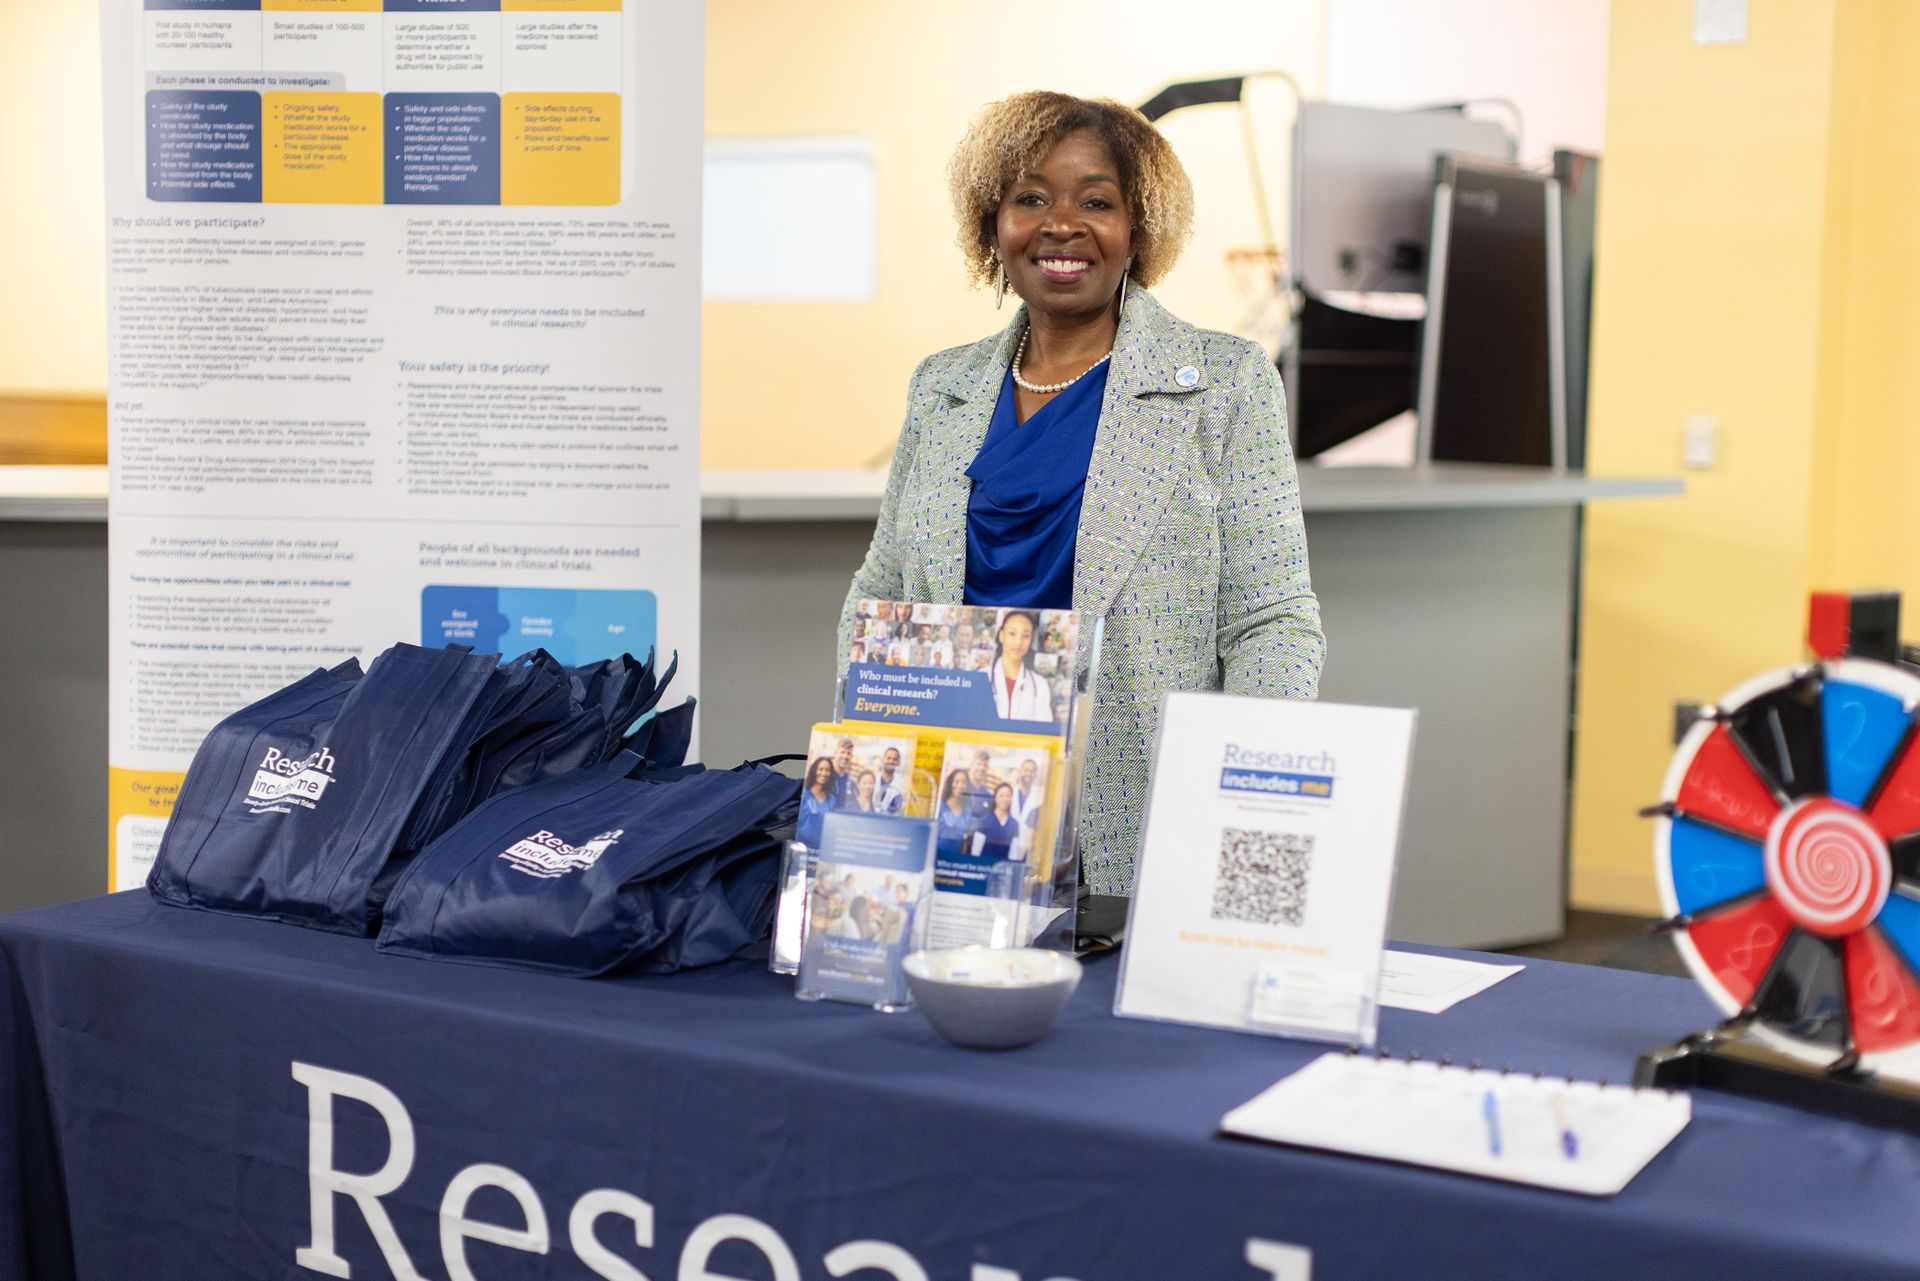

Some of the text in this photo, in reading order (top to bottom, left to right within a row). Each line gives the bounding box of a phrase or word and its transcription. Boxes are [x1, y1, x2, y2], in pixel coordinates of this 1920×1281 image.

[111, 216, 266, 230] Why should we participate?
[398, 361, 550, 376] Your safety is the priority!
[419, 542, 640, 558] People of all backgrounds are needed
[419, 556, 592, 571] and welcome in clinical trials.
[859, 670, 972, 688] Who must be included in
[857, 686, 938, 700] clinical research?
[855, 698, 921, 717] Everyone.
[1222, 743, 1336, 772] Research
[1222, 771, 1299, 793] includes
[1178, 929, 1211, 943] Scan
[1214, 934, 1233, 946] me
[1237, 935, 1250, 948] to
[1253, 937, 1288, 951] learn
